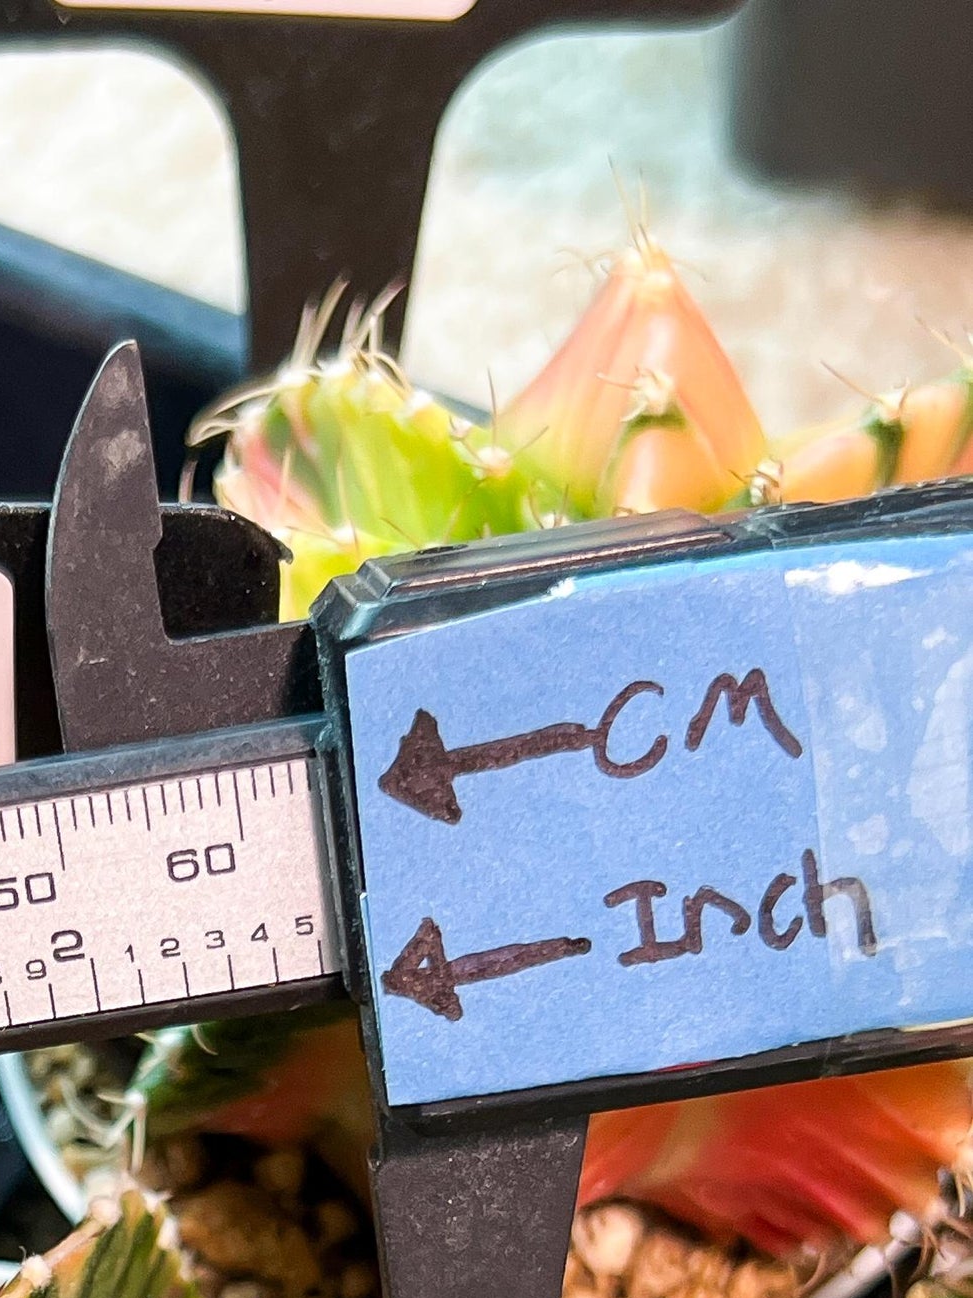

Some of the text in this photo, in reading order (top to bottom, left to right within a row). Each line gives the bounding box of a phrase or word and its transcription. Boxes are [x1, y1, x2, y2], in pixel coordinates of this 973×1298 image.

[594, 668, 802, 779] CM
[166, 842, 236, 882] 60
[25, 959, 47, 981] 9
[50, 929, 85, 963] 2
[125, 944, 135, 963] 1
[160, 937, 181, 958] 2
[205, 930, 225, 949] 3
[250, 922, 269, 942] 4
[294, 914, 314, 936] 5
[604, 849, 877, 967] Inch
